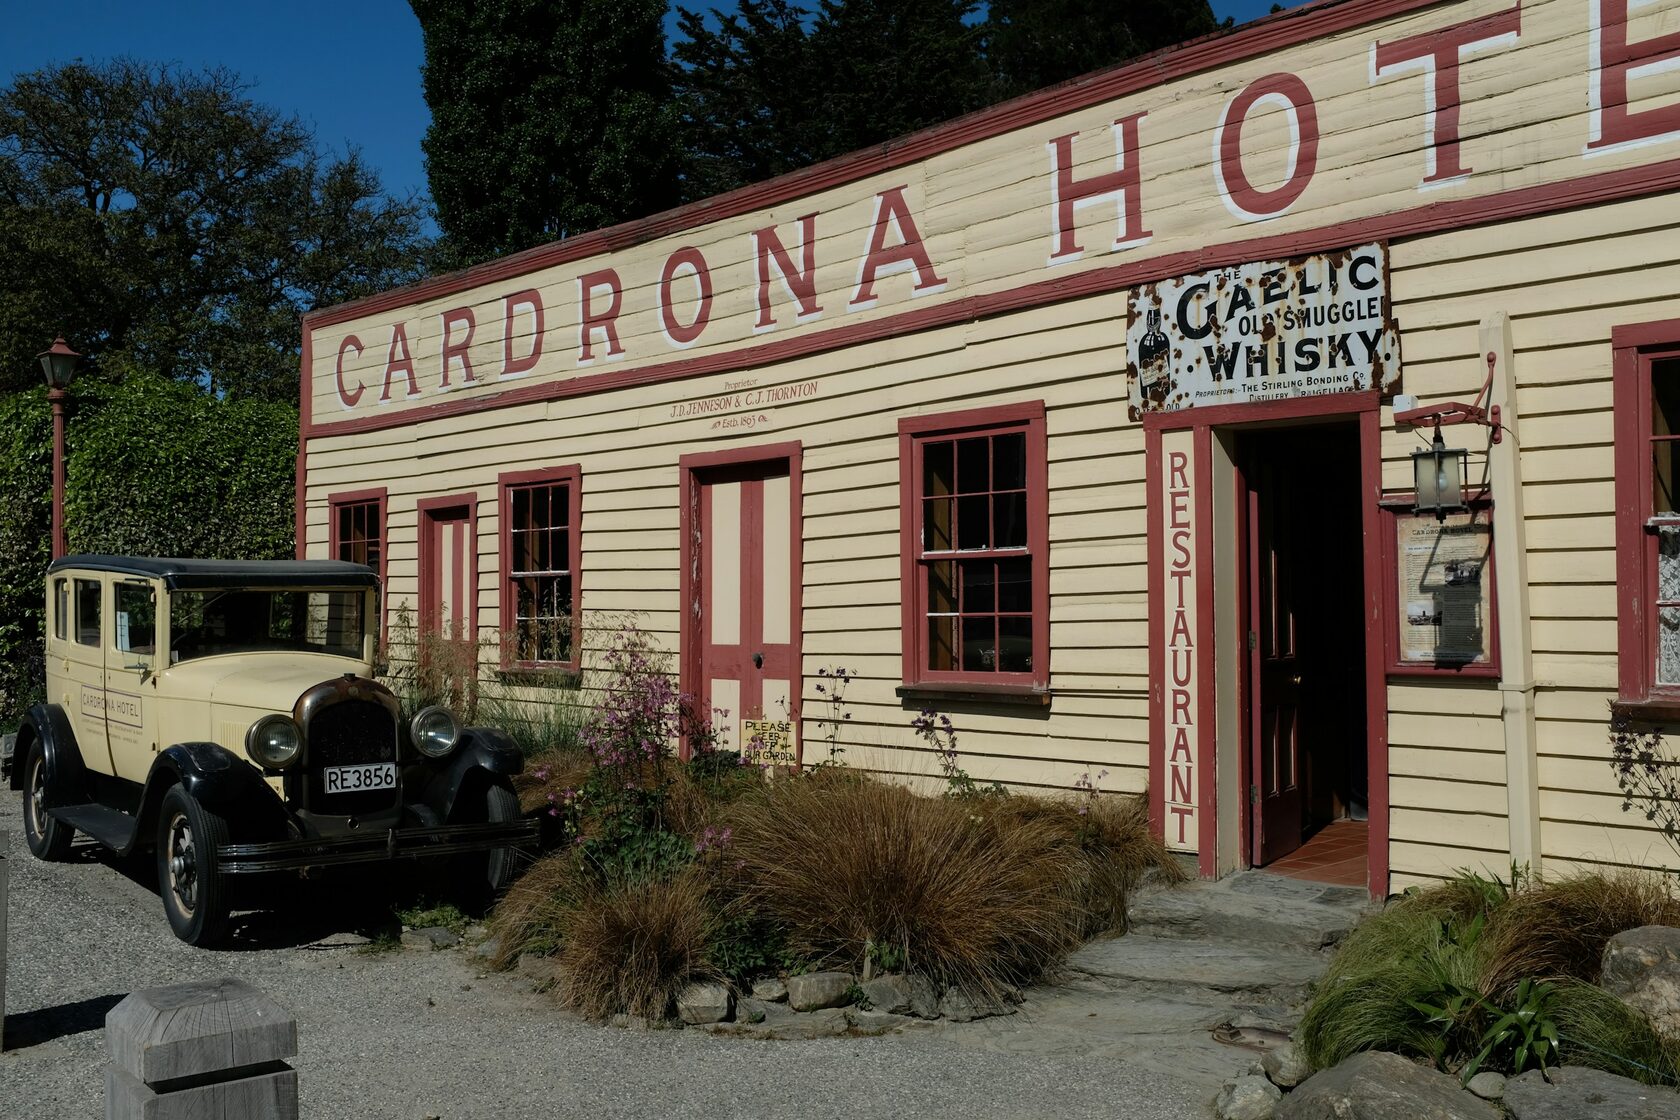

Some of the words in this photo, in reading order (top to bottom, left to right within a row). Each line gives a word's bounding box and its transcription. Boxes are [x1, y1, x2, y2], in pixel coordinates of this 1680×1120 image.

[1214, 270, 1241, 283] THE
[334, 184, 948, 411] CARDRONA
[1176, 255, 1380, 340] GAELIC
[724, 378, 758, 391] Proprietor
[734, 395, 742, 408] &
[766, 381, 818, 402] THORNTON
[1241, 383, 1258, 393] THE
[1261, 378, 1303, 391] STIRLING
[1306, 374, 1349, 386] BONDING
[722, 417, 740, 429] Estb.
[1168, 451, 1194, 844] RESTAURANT
[82, 692, 116, 712] CARDRONA
[117, 700, 139, 718] HOTEL
[745, 721, 791, 733] PLEASE
[763, 750, 796, 762] GARDEN
[328, 766, 394, 791] RE3856
